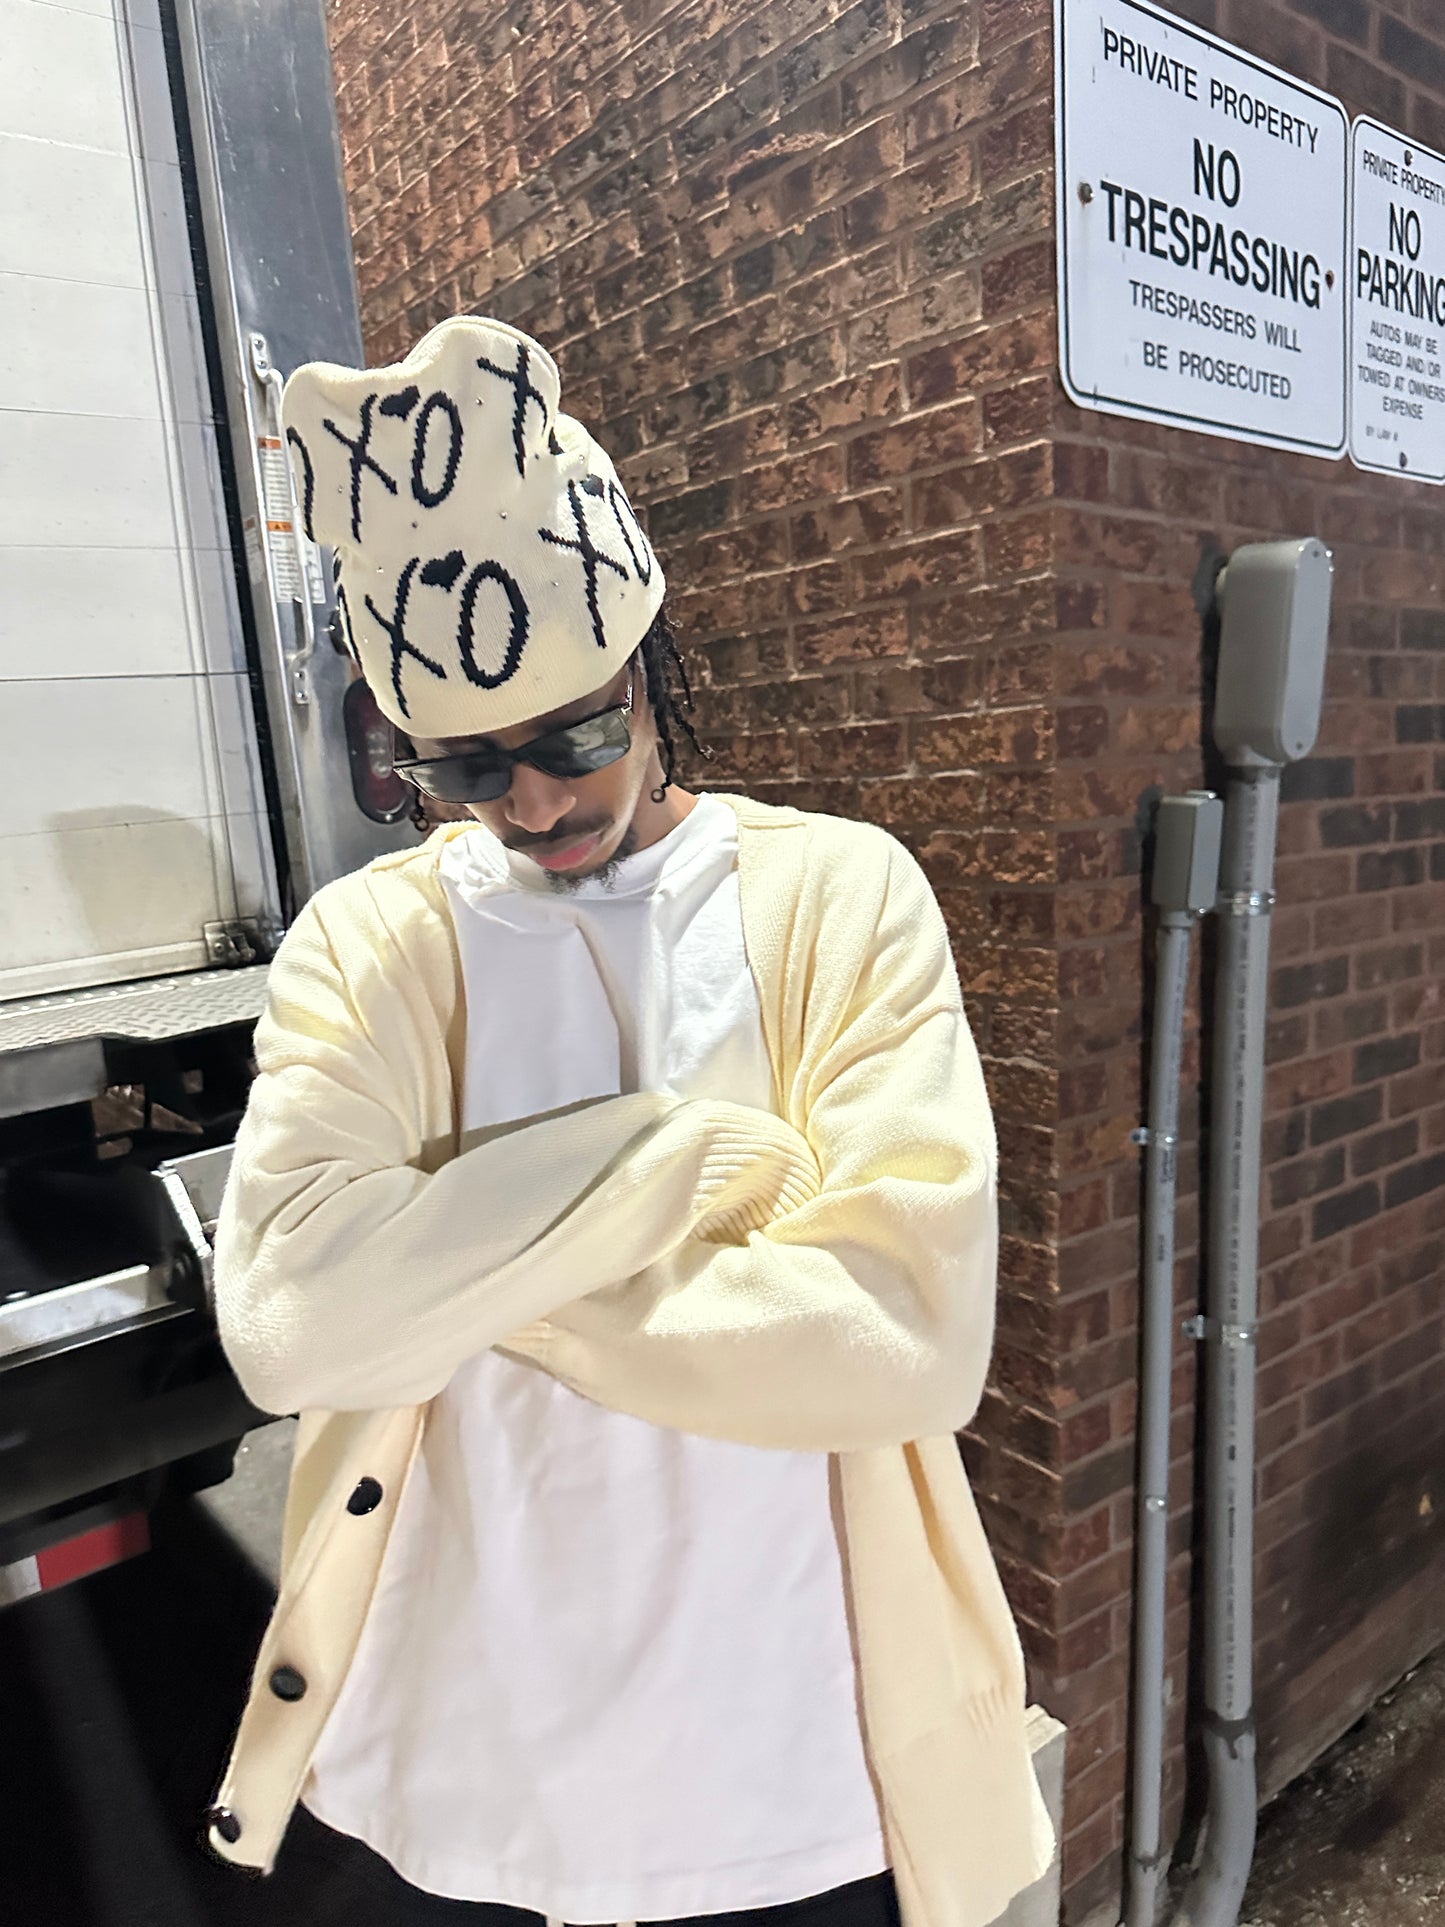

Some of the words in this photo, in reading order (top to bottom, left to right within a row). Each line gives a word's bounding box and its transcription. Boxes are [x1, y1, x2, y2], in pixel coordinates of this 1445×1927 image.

[1103, 27, 1198, 101] PRIVATE
[1210, 78, 1319, 154] PROPERTY
[1193, 137, 1241, 207] NO
[1363, 150, 1398, 185] PRIVATE
[1101, 180, 1321, 309] TRESPASSING
[1389, 202, 1421, 261] NO
[1129, 279, 1257, 340] TRESPASSERS
[1264, 320, 1302, 353] WILL
[1358, 248, 1445, 327] PARKING
[1366, 342, 1402, 367] TAGGED
[1406, 355, 1424, 374] AND
[1428, 361, 1441, 379] OR
[1370, 320, 1400, 344] AUTOS
[1405, 330, 1423, 349] MAY
[1426, 337, 1438, 355] BE
[1143, 341, 1168, 371] BE
[1179, 349, 1291, 400] PROSECUTED
[1358, 365, 1391, 388] TOWED
[1394, 376, 1405, 391] AT
[1383, 396, 1423, 420] EXPENSE
[323, 388, 464, 544] XO
[364, 556, 530, 719] XO
